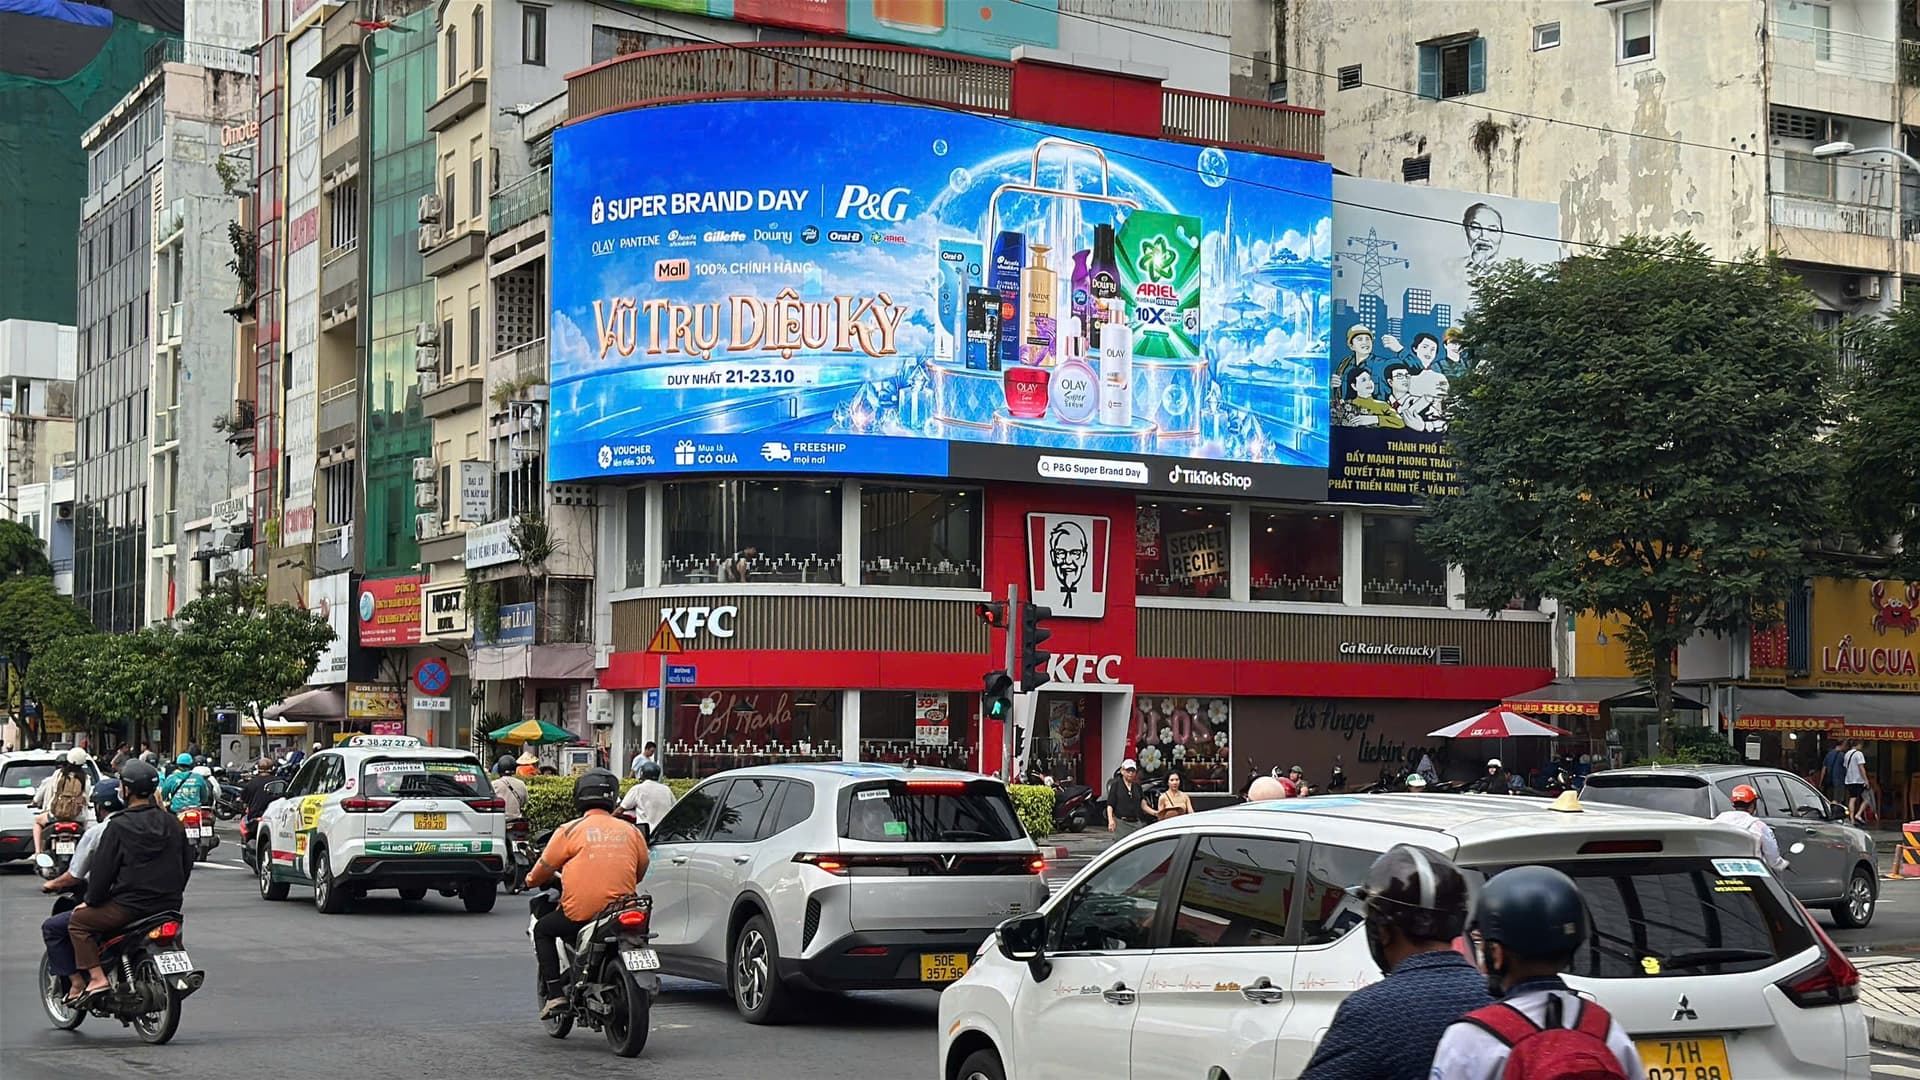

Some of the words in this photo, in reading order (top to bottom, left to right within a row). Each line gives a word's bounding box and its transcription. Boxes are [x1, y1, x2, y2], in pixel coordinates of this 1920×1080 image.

[608, 194, 667, 220] SUPER
[671, 191, 753, 216] BRAND
[757, 190, 809, 211] DAY
[835, 184, 911, 221] P&G
[703, 231, 747, 242] Gillette
[754, 229, 792, 244] Downy
[829, 232, 860, 241] Oral-B
[592, 239, 615, 254] OLAY
[620, 235, 660, 248] PANTENE
[659, 262, 686, 277] Mall
[695, 263, 727, 275] 100%
[730, 260, 771, 274] CHÍNH
[774, 259, 815, 273] HÀNG
[1092, 279, 1116, 292] Downy
[1136, 283, 1178, 298] ARIEL
[592, 296, 638, 360] VŨ
[643, 298, 720, 360] TRỤ
[728, 287, 830, 360] DIỆU
[832, 291, 907, 358] KỲ
[1135, 307, 1166, 325] 10X
[1106, 348, 1126, 358] OLAY
[667, 374, 690, 386] DUY
[692, 370, 721, 386] NHẤT
[726, 370, 795, 384] 21-23.10
[1061, 379, 1087, 391] OLAY
[1017, 382, 1038, 392] OLAY
[613, 445, 651, 455] VOUCHER
[793, 443, 846, 453] FREESHIP
[1387, 441, 1417, 453] THÀNH
[1419, 442, 1437, 454] PHỐ
[636, 456, 655, 466] 30%
[698, 453, 713, 464] CÓ
[715, 452, 738, 464] QUÀ
[793, 455, 808, 465] mọi
[810, 454, 826, 464] nơi
[1367, 455, 1395, 467] MẠNH
[1397, 456, 1427, 467] PHONG
[1053, 463, 1072, 473] P&G
[1073, 464, 1097, 475] Super
[1100, 465, 1123, 475] Brand
[1125, 467, 1141, 478] Day
[1344, 464, 1372, 478] QUYẾT
[1376, 467, 1395, 479] TÂM
[1397, 469, 1420, 481] THỰC
[1422, 470, 1443, 483] HIỆN
[1182, 469, 1221, 485] TikTok
[1222, 473, 1251, 490] Shop
[1328, 477, 1352, 489] PHÁT
[1356, 477, 1381, 492] TRIỂN
[1384, 481, 1406, 493] KINH
[1427, 483, 1445, 496] VĂN
[1170, 530, 1222, 555] SECRET
[1173, 551, 1224, 575] RECIPE
[661, 606, 738, 638] KFC
[1340, 642, 1356, 654] Gà
[1357, 643, 1381, 654] Rán
[1383, 644, 1437, 658] Kentucky
[1823, 634, 1867, 673] LẨU
[1870, 647, 1916, 675] CUA
[1047, 653, 1122, 684] KFC
[1320, 704, 1375, 740] finger
[934, 955, 955, 966] 50E
[927, 967, 964, 979] 357.96
[1660, 1041, 1702, 1064] 71H
